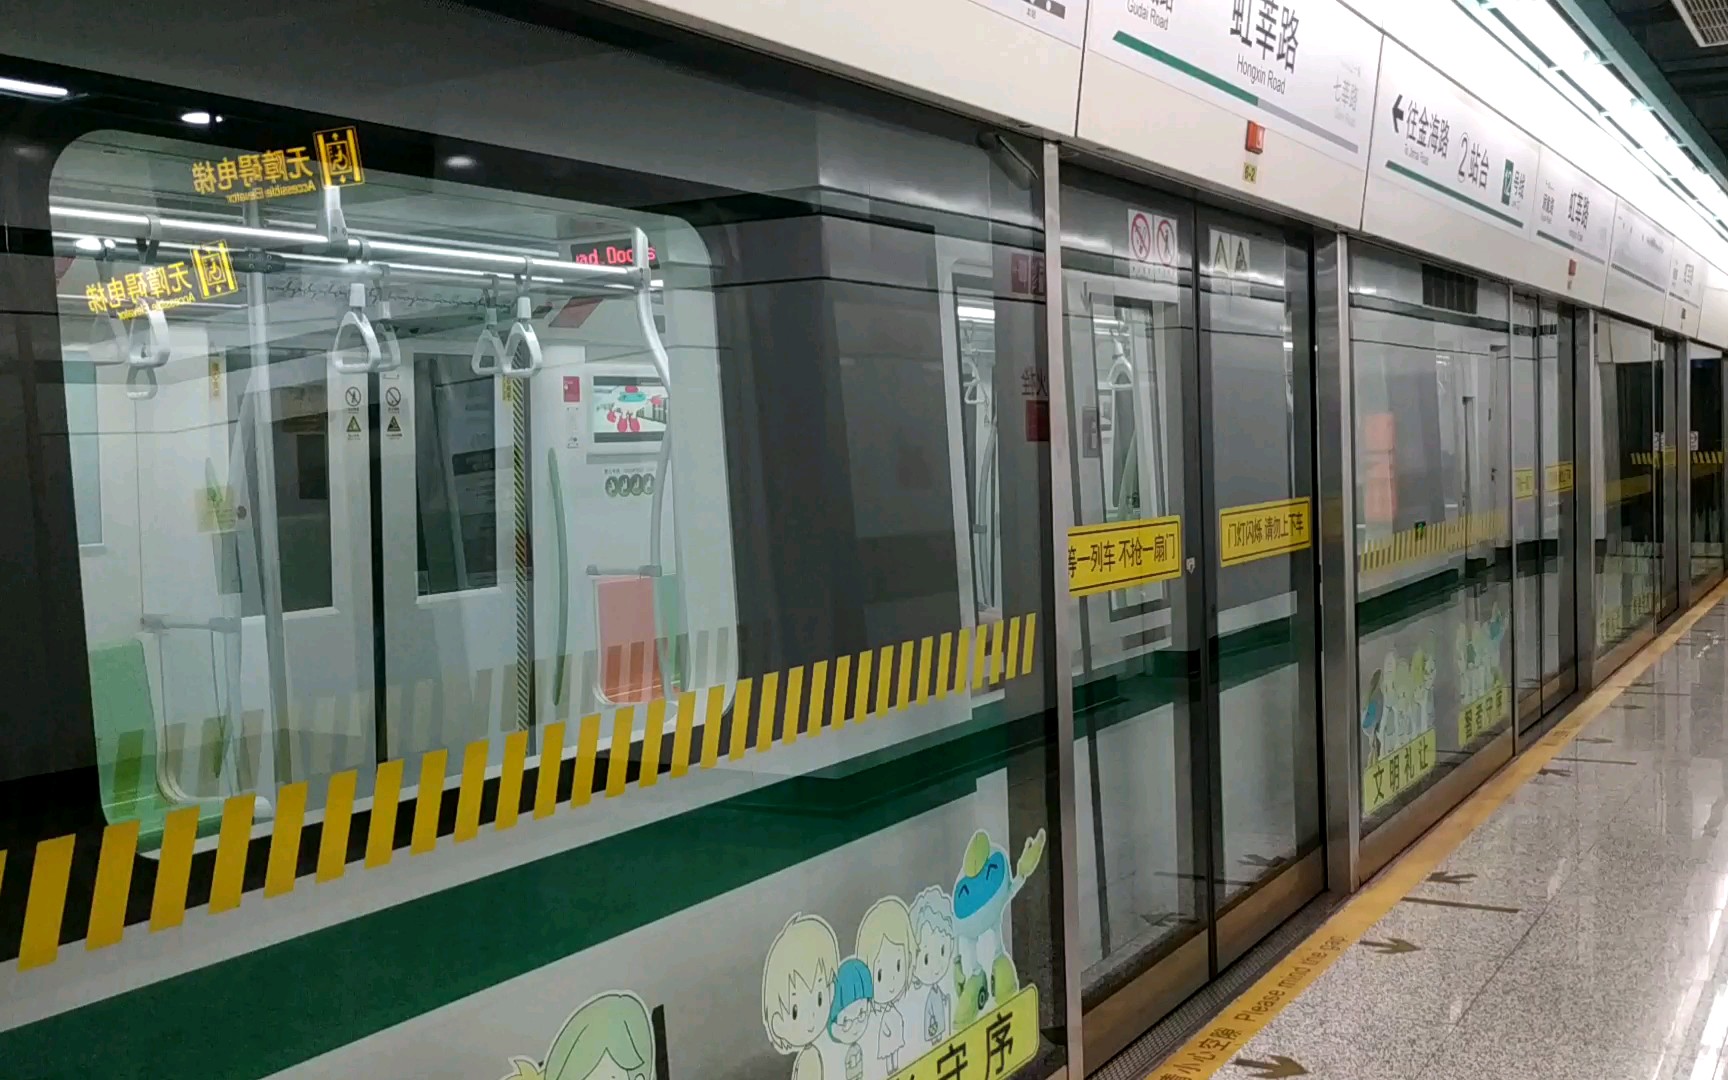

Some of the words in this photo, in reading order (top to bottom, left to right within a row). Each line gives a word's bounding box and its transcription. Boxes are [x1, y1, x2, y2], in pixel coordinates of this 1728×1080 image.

[1150, 8, 1169, 31] Road
[1237, 53, 1267, 85] Hongxin
[1266, 69, 1287, 95] Road
[1406, 99, 1450, 158] 往金海路
[606, 246, 656, 264] Doos
[1264, 511, 1304, 542] 请勿上下车
[1118, 533, 1176, 569] 不抢一扇门
[1373, 735, 1429, 805] 文明礼让
[1235, 988, 1286, 1023] Please
[1278, 966, 1312, 991] mind
